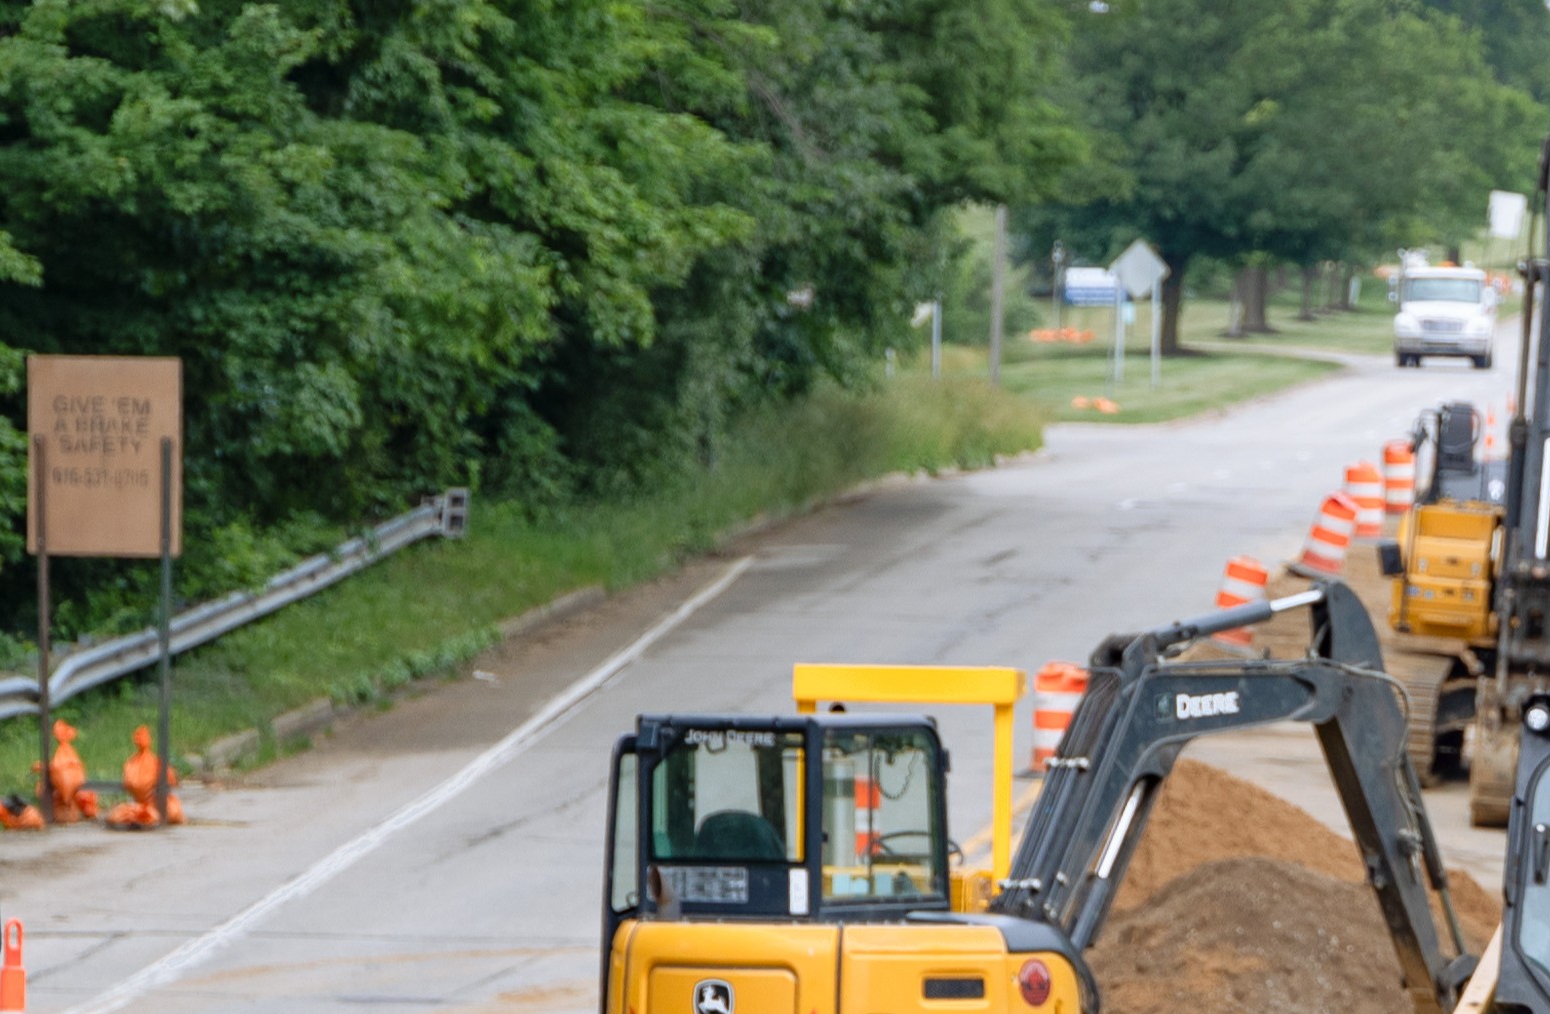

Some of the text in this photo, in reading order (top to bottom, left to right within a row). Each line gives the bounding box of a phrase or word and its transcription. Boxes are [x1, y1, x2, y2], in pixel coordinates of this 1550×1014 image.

[52, 394, 105, 414] GIVE
[59, 434, 142, 455] SAFETY
[1176, 691, 1239, 719] DEERE
